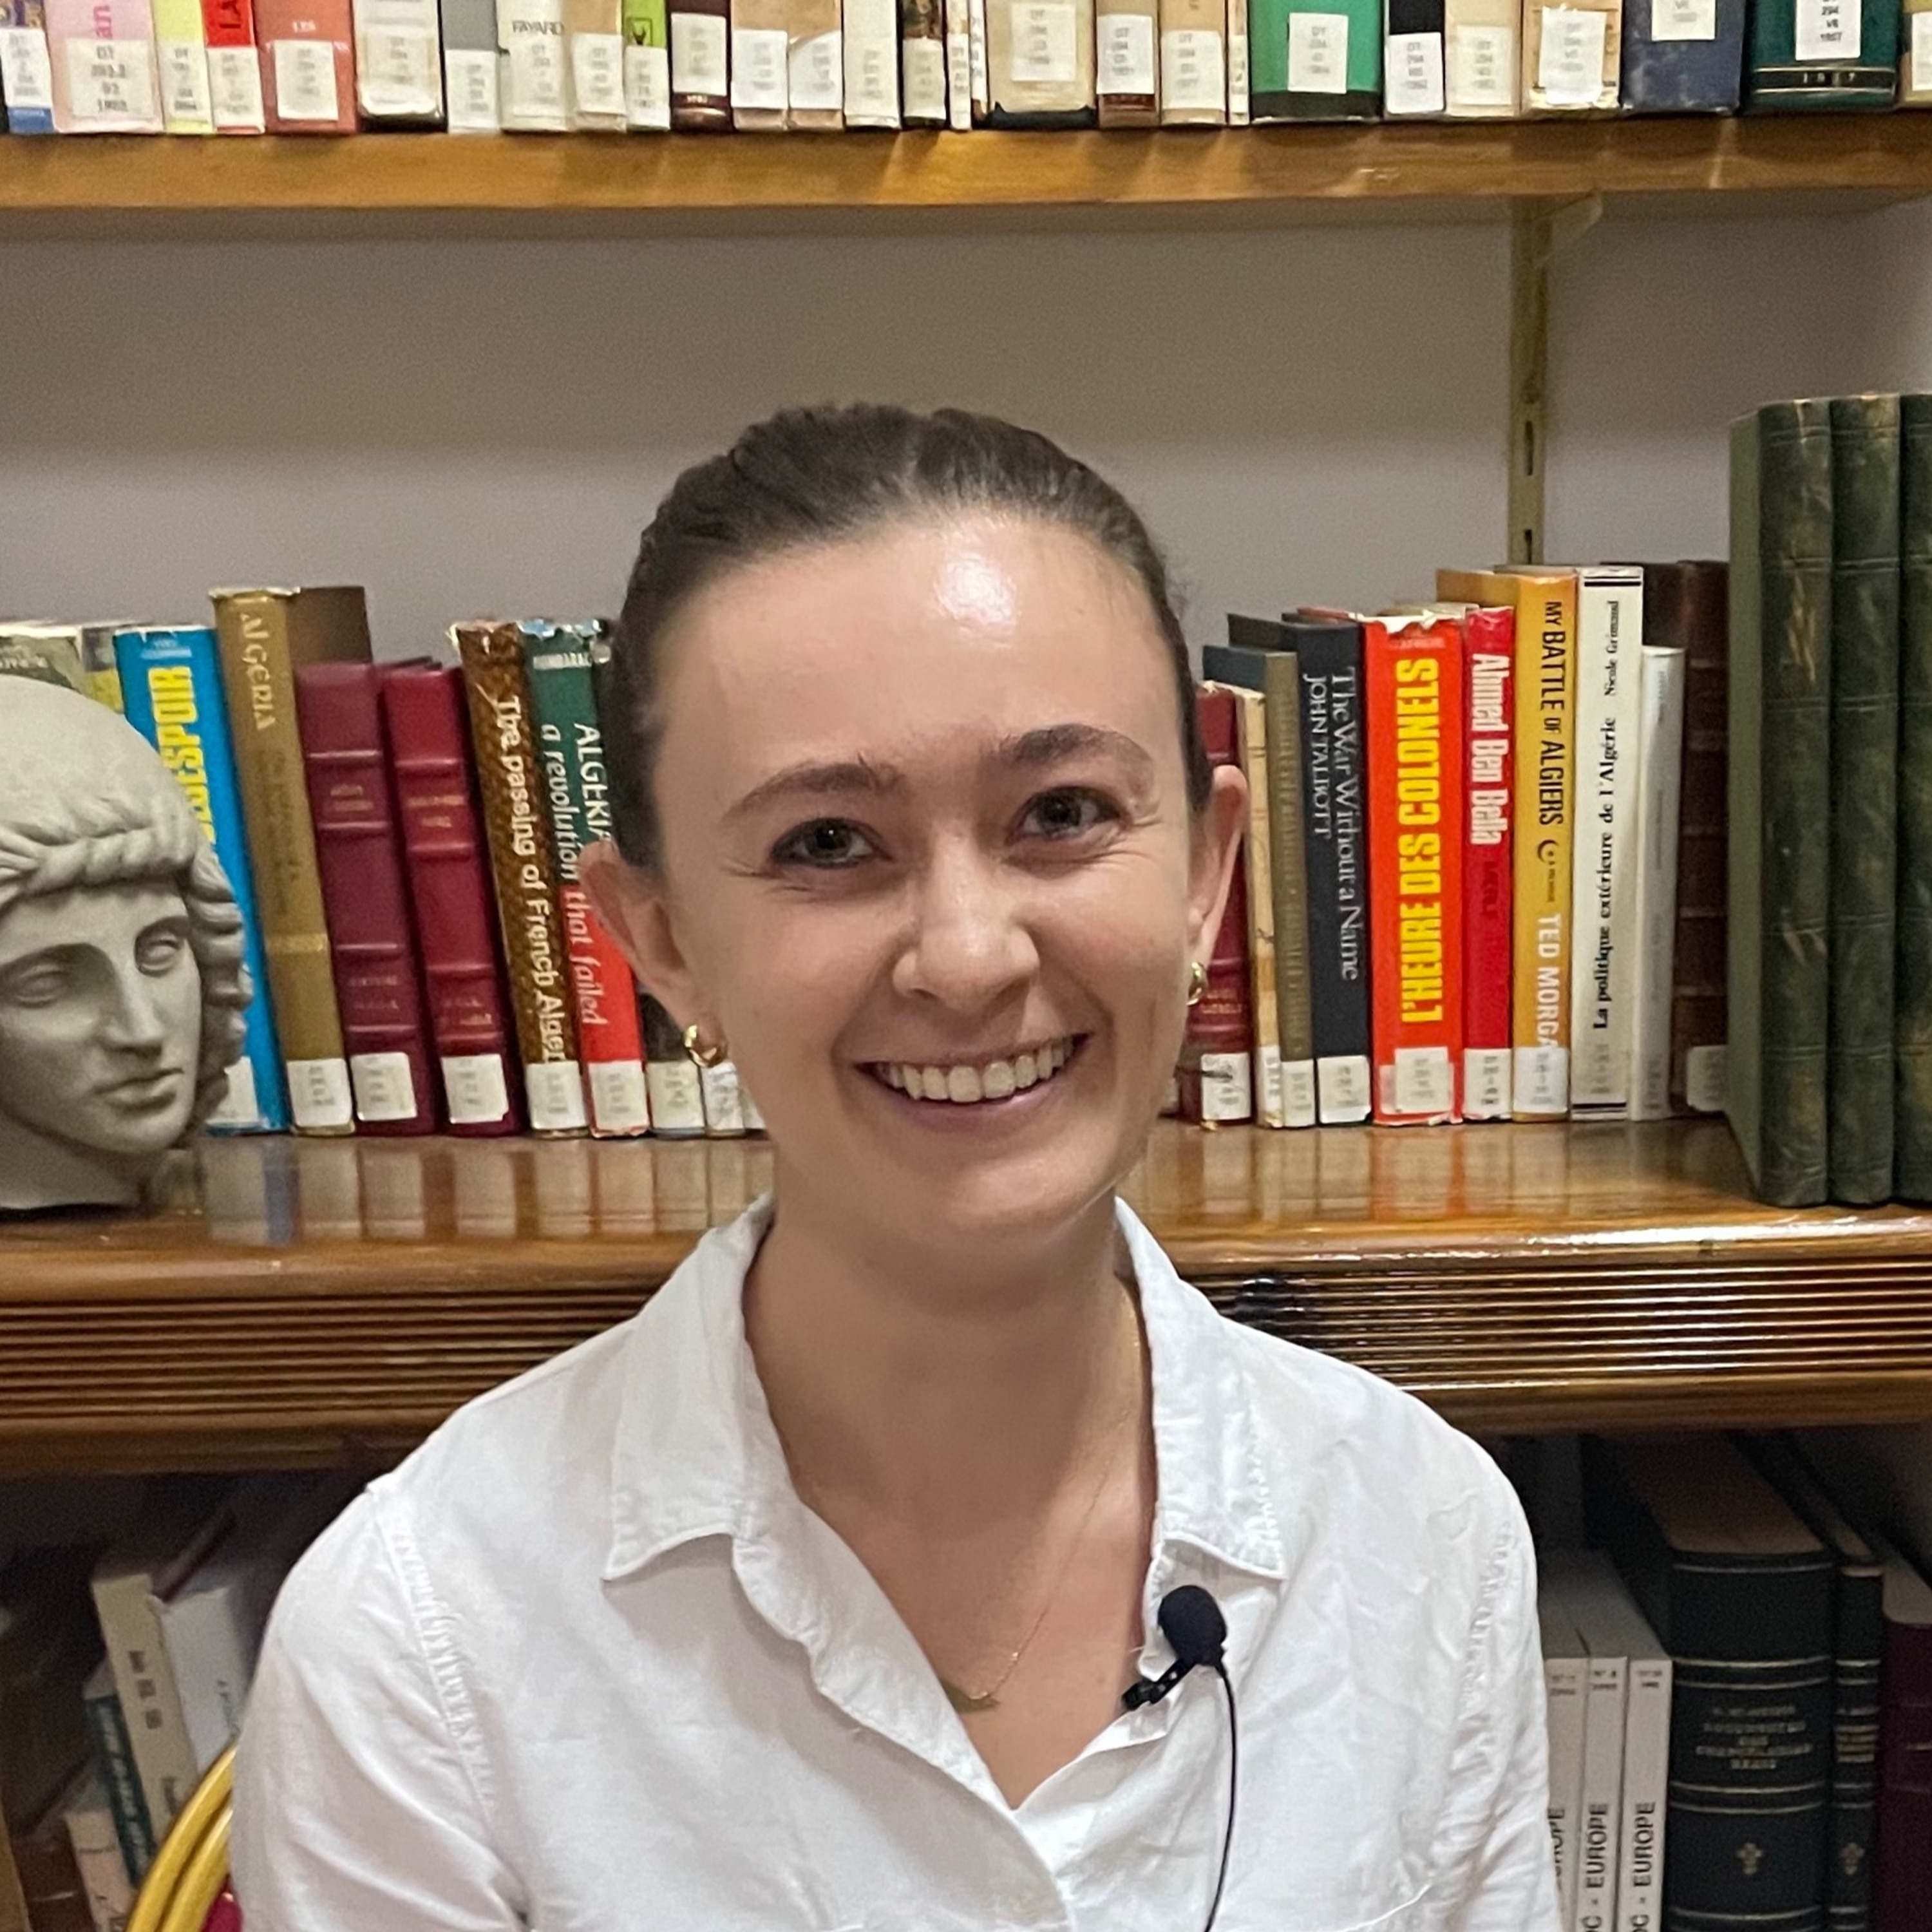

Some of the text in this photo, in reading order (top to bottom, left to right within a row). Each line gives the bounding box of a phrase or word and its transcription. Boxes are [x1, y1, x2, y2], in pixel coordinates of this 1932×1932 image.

[513, 20, 565, 36] FAYARD
[240, 612, 276, 730] ALGERIA
[1331, 666, 1357, 723] The
[1539, 600, 1567, 826] MY BATTLE OF ALGIERS
[1303, 672, 1332, 840] JOHN TALBOTT
[1333, 720, 1358, 775] War
[1396, 658, 1441, 826] COLONELS
[1470, 653, 1510, 846] Ahmed Ben Bella
[496, 694, 565, 1062] The passing of French Alger
[541, 723, 609, 1025] a revolution that failed
[1339, 886, 1356, 902] a
[1398, 832, 1441, 895] DES
[1593, 716, 1618, 1030] La politique extérieure de l'Algérie
[1339, 904, 1365, 981] Name
[1399, 902, 1444, 1023] L'HEURE
[1536, 913, 1562, 1048] TED MORGA
[1586, 1803, 1609, 1888] EUROPE
[1633, 1801, 1656, 1886] EUROPE
